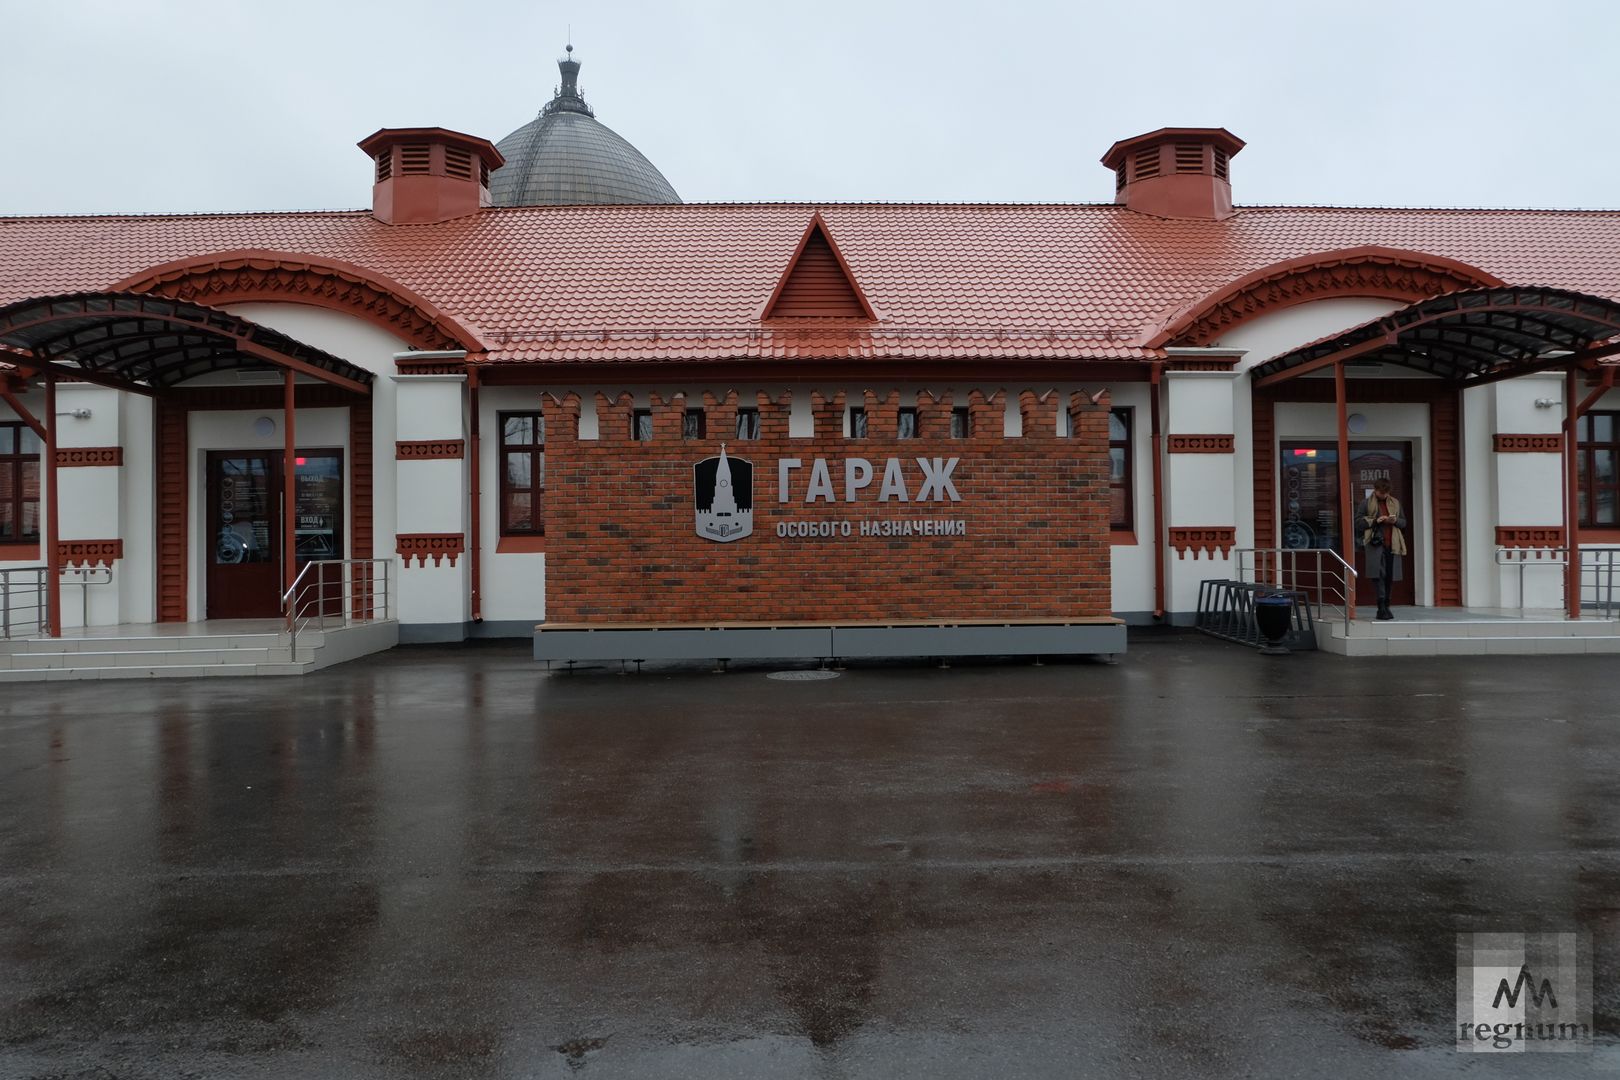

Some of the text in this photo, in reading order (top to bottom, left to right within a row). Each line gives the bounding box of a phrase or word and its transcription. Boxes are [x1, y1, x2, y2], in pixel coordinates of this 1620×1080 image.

[778, 457, 962, 503] ГАРАЖ
[300, 516, 319, 524] ВХОД
[776, 519, 966, 538] ОСОБОГО НАЗНАЧЕНИЯ
